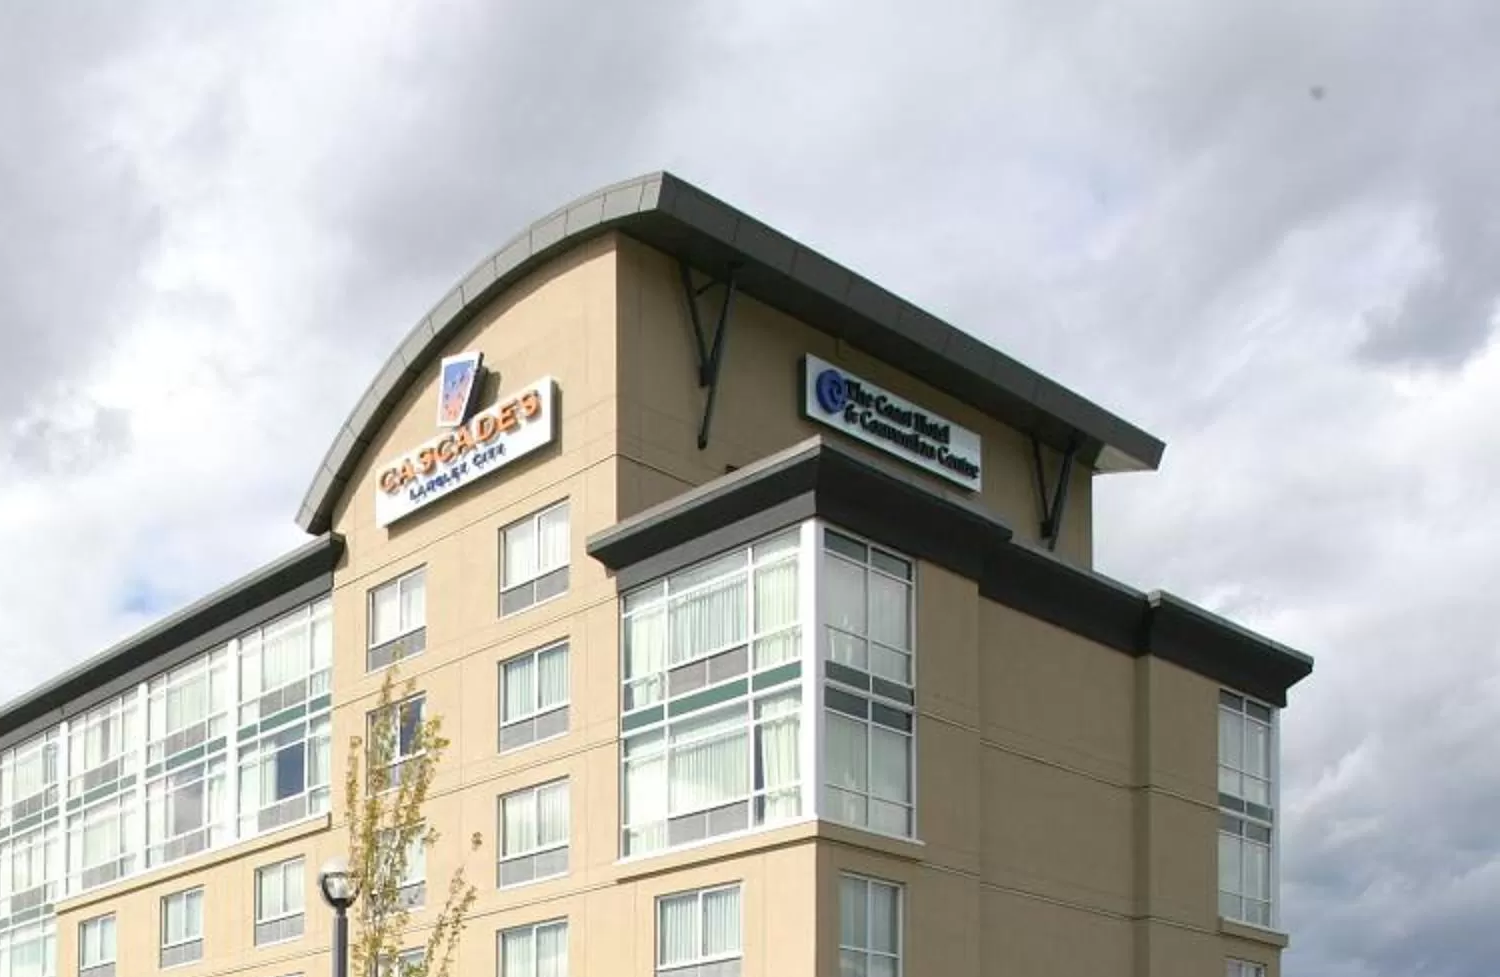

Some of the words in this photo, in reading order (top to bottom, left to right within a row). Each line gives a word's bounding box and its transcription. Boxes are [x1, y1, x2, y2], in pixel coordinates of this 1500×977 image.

[380, 388, 542, 495] CASCADES
[409, 461, 469, 502] LANGLEY
[472, 443, 507, 469] CITY
